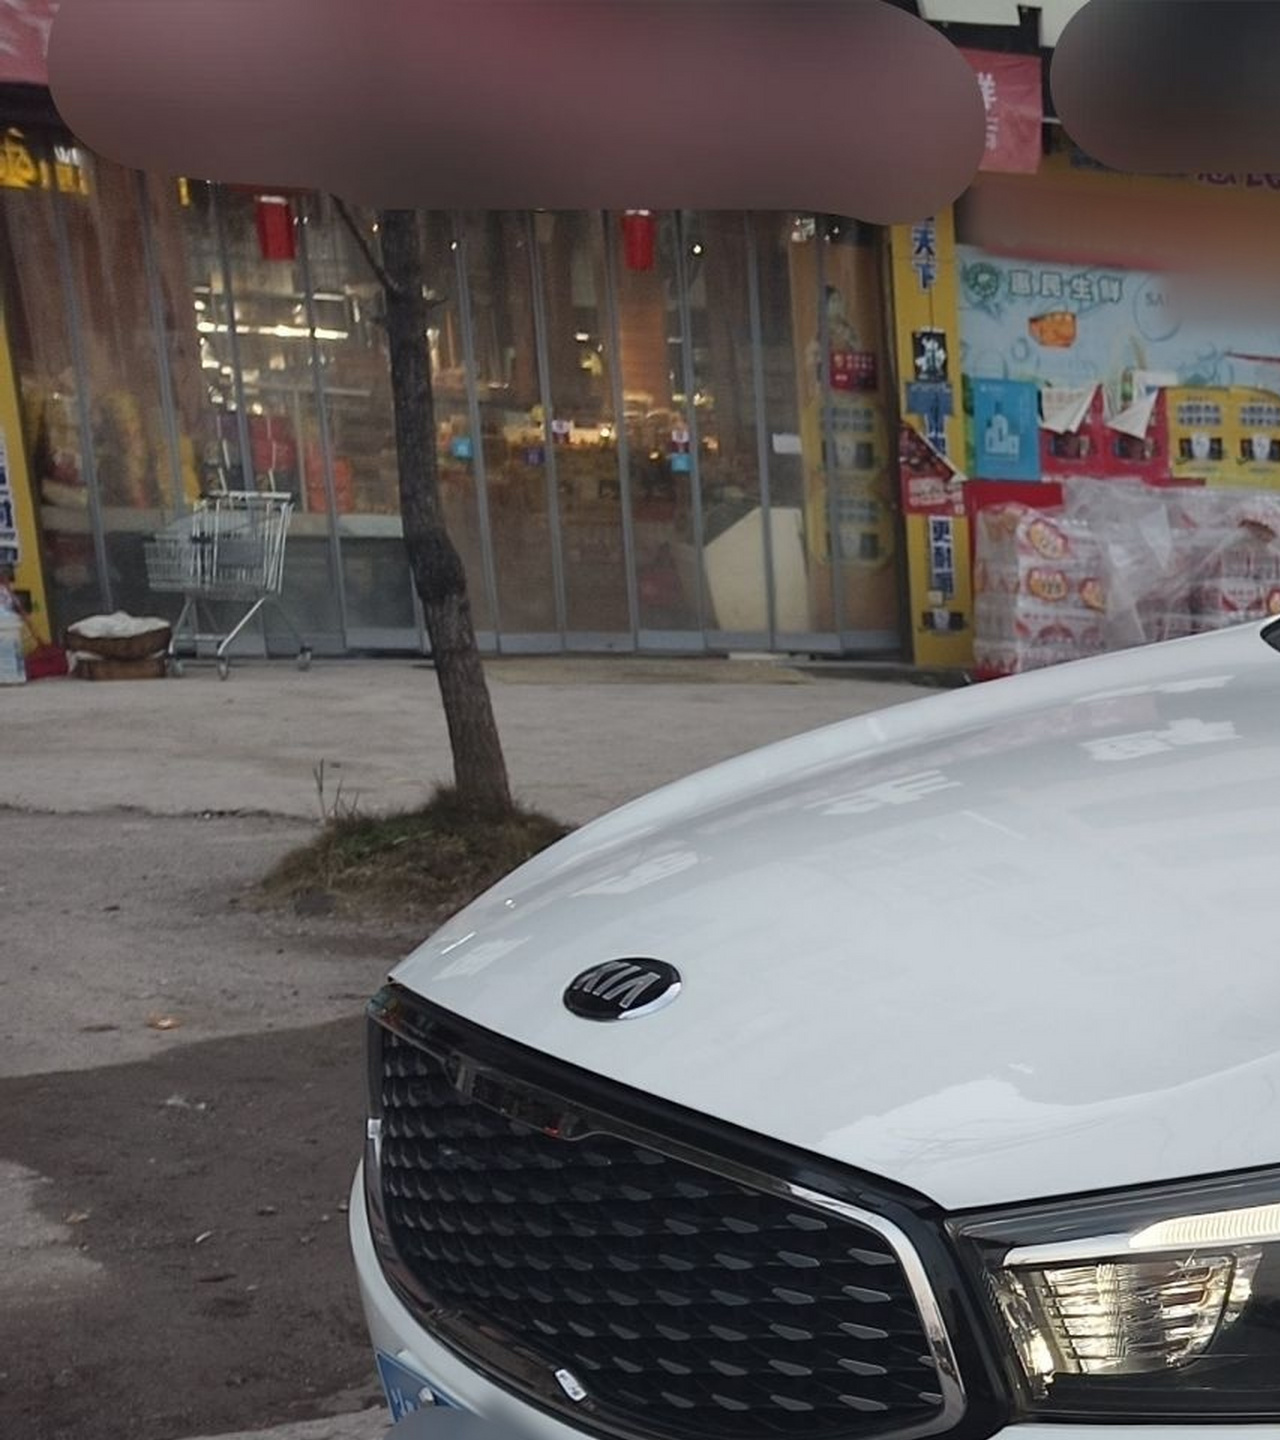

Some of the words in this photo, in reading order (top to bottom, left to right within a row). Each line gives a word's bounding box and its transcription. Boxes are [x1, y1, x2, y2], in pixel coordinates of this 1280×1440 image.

[1008, 269, 1122, 303] 惠民生鲜
[573, 961, 661, 1009] KIA
